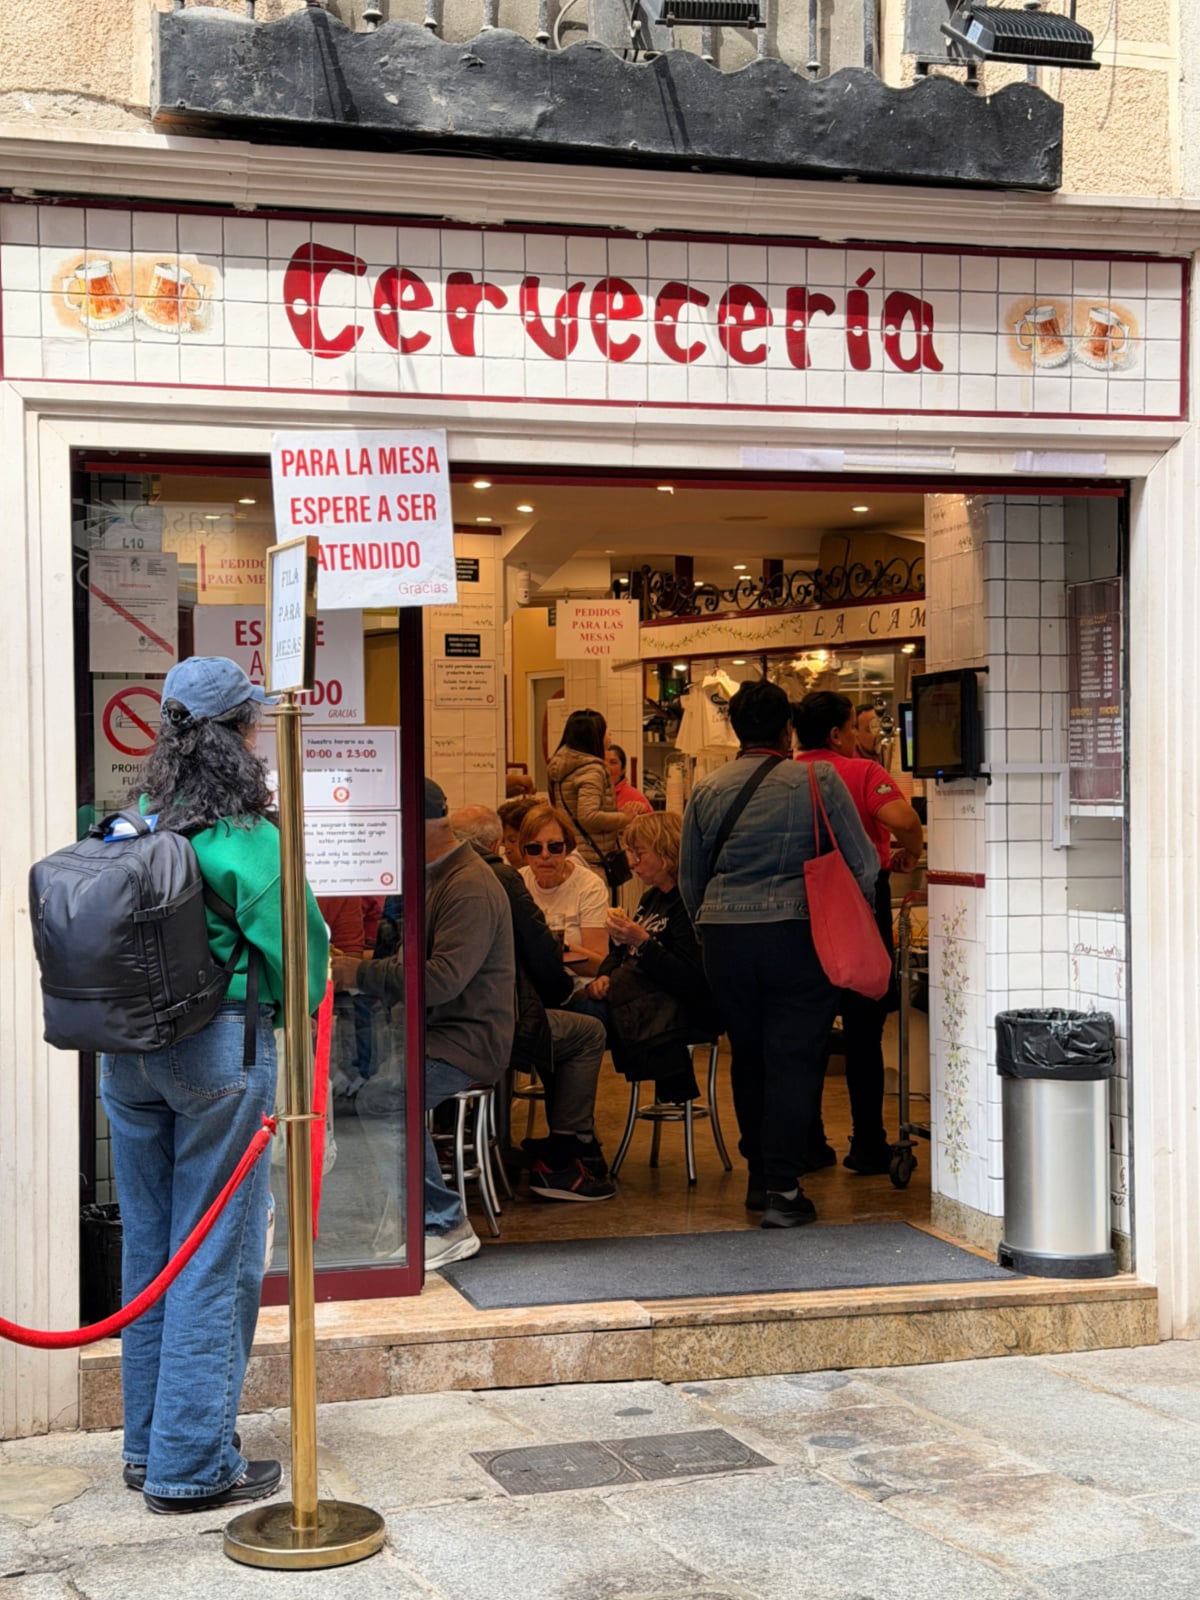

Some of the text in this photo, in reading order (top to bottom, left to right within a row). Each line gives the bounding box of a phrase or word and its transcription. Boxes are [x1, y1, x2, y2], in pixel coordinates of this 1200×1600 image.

[284, 242, 943, 372] Cervecería
[281, 446, 440, 477] PARA LA MESA
[290, 494, 437, 525] ESPERE A SER
[122, 537, 144, 550] L10
[317, 541, 421, 571] ATENDIDO
[208, 575, 244, 585] PARA
[281, 567, 299, 588] FILA
[398, 582, 450, 595] Gracias
[278, 602, 301, 623] PARA
[575, 608, 621, 617] PEDIDOS
[572, 621, 624, 630] PARA LAS
[813, 613, 845, 639] LA
[580, 633, 616, 641] MESAS
[275, 636, 302, 658] MESAS
[584, 646, 611, 655] AQUI
[250, 651, 264, 676] A
[328, 709, 357, 719] GRACIAS
[306, 749, 332, 758] 10:00
[347, 749, 377, 758] 23:00
